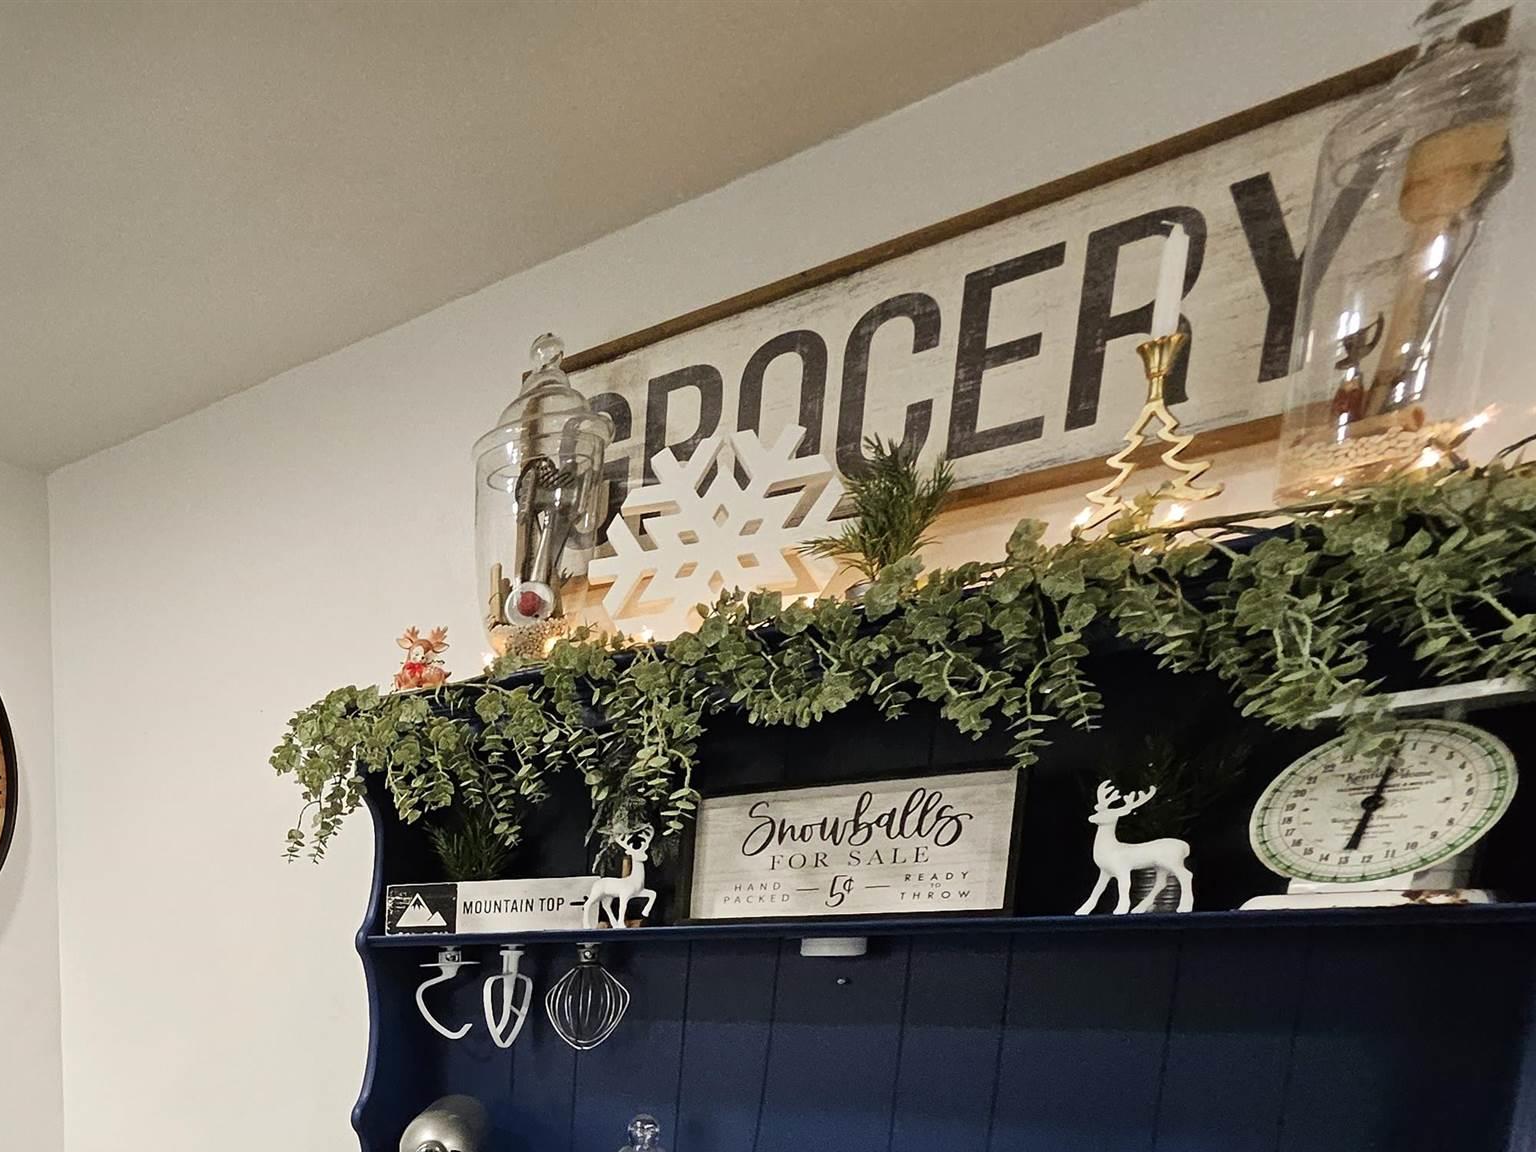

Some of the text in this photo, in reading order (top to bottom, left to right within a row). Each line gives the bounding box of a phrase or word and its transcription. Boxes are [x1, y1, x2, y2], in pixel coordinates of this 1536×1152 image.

[559, 128, 1406, 548] GROCERY
[742, 787, 973, 857] Snowballs
[769, 846, 930, 871] FOR SALE
[904, 871, 970, 882] READY
[734, 881, 782, 892] HAND
[825, 874, 854, 908] 5¢
[900, 889, 971, 900] THROW
[462, 897, 565, 915] MOUNTAIN TOP
[723, 893, 791, 904] PACKED
